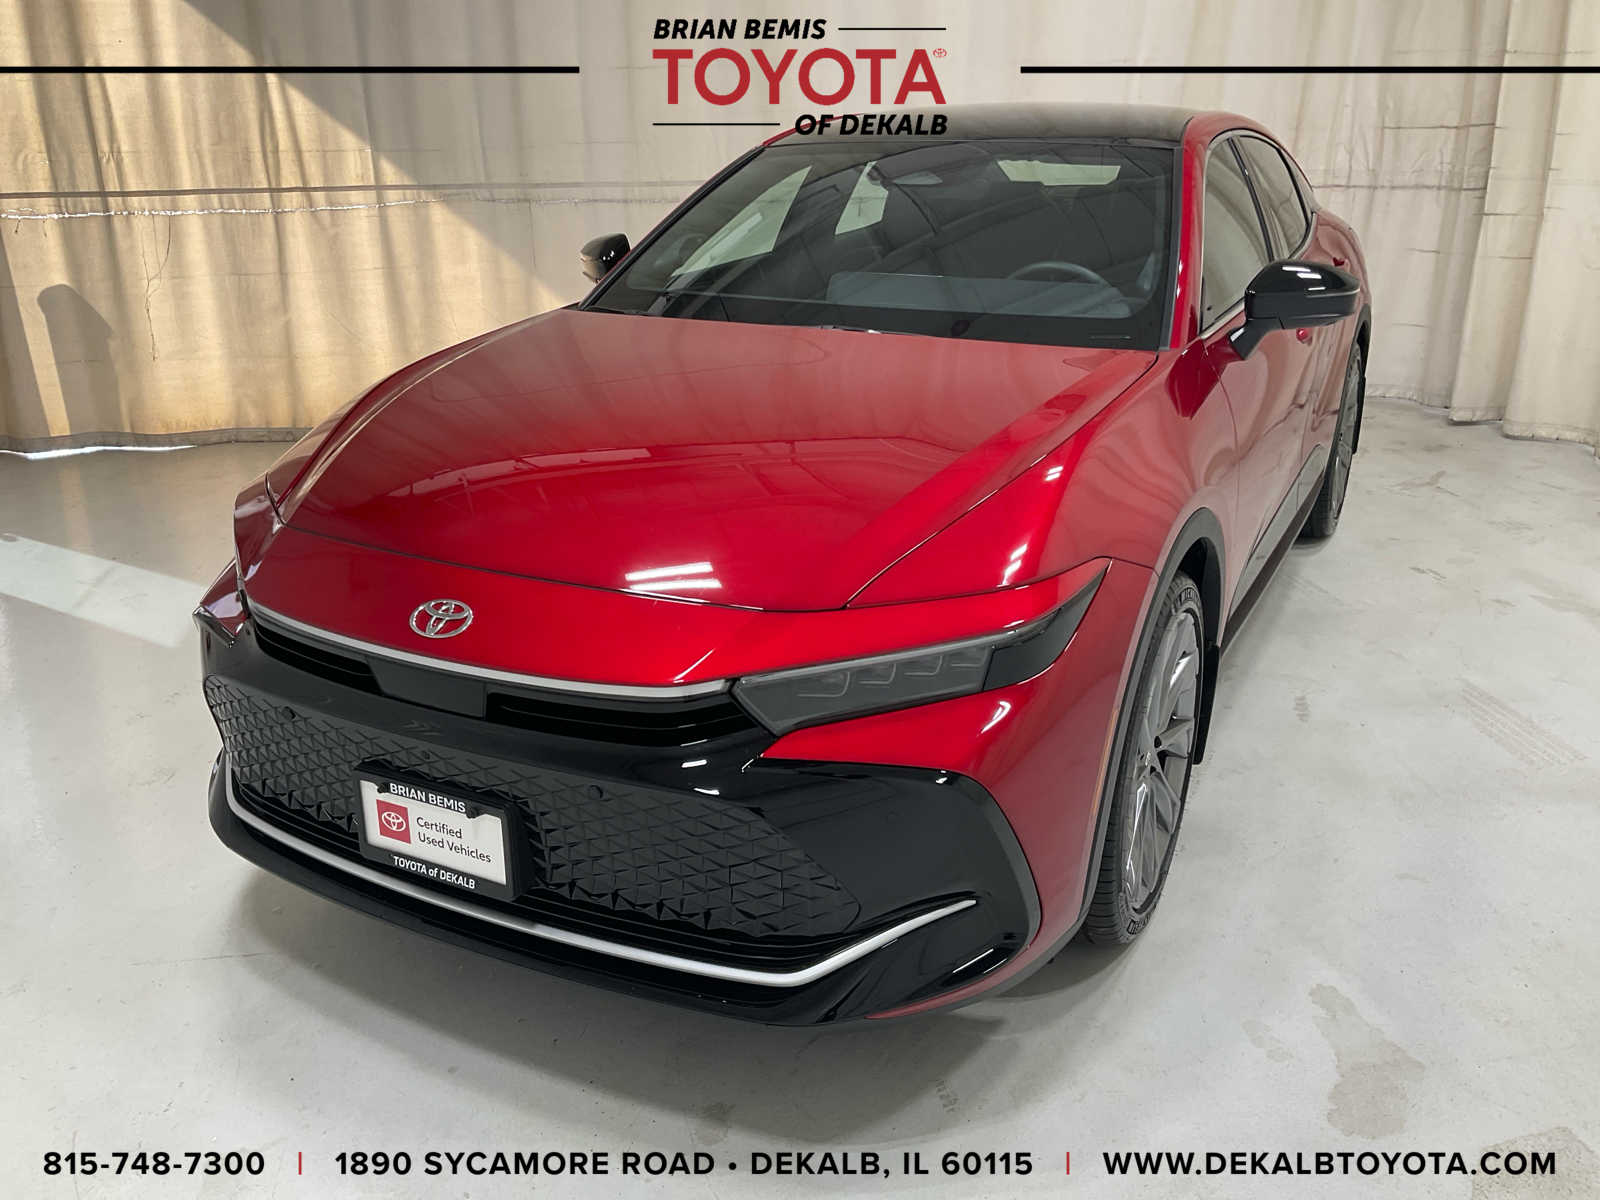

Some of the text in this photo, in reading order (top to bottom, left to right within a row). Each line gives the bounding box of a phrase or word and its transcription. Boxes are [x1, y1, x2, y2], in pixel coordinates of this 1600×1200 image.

[389, 782, 466, 813] BRIAN BEMIS
[416, 816, 462, 839] Certified
[418, 832, 492, 863] Used Vehicles
[393, 855, 476, 889] TOYOTA of DEKALB
